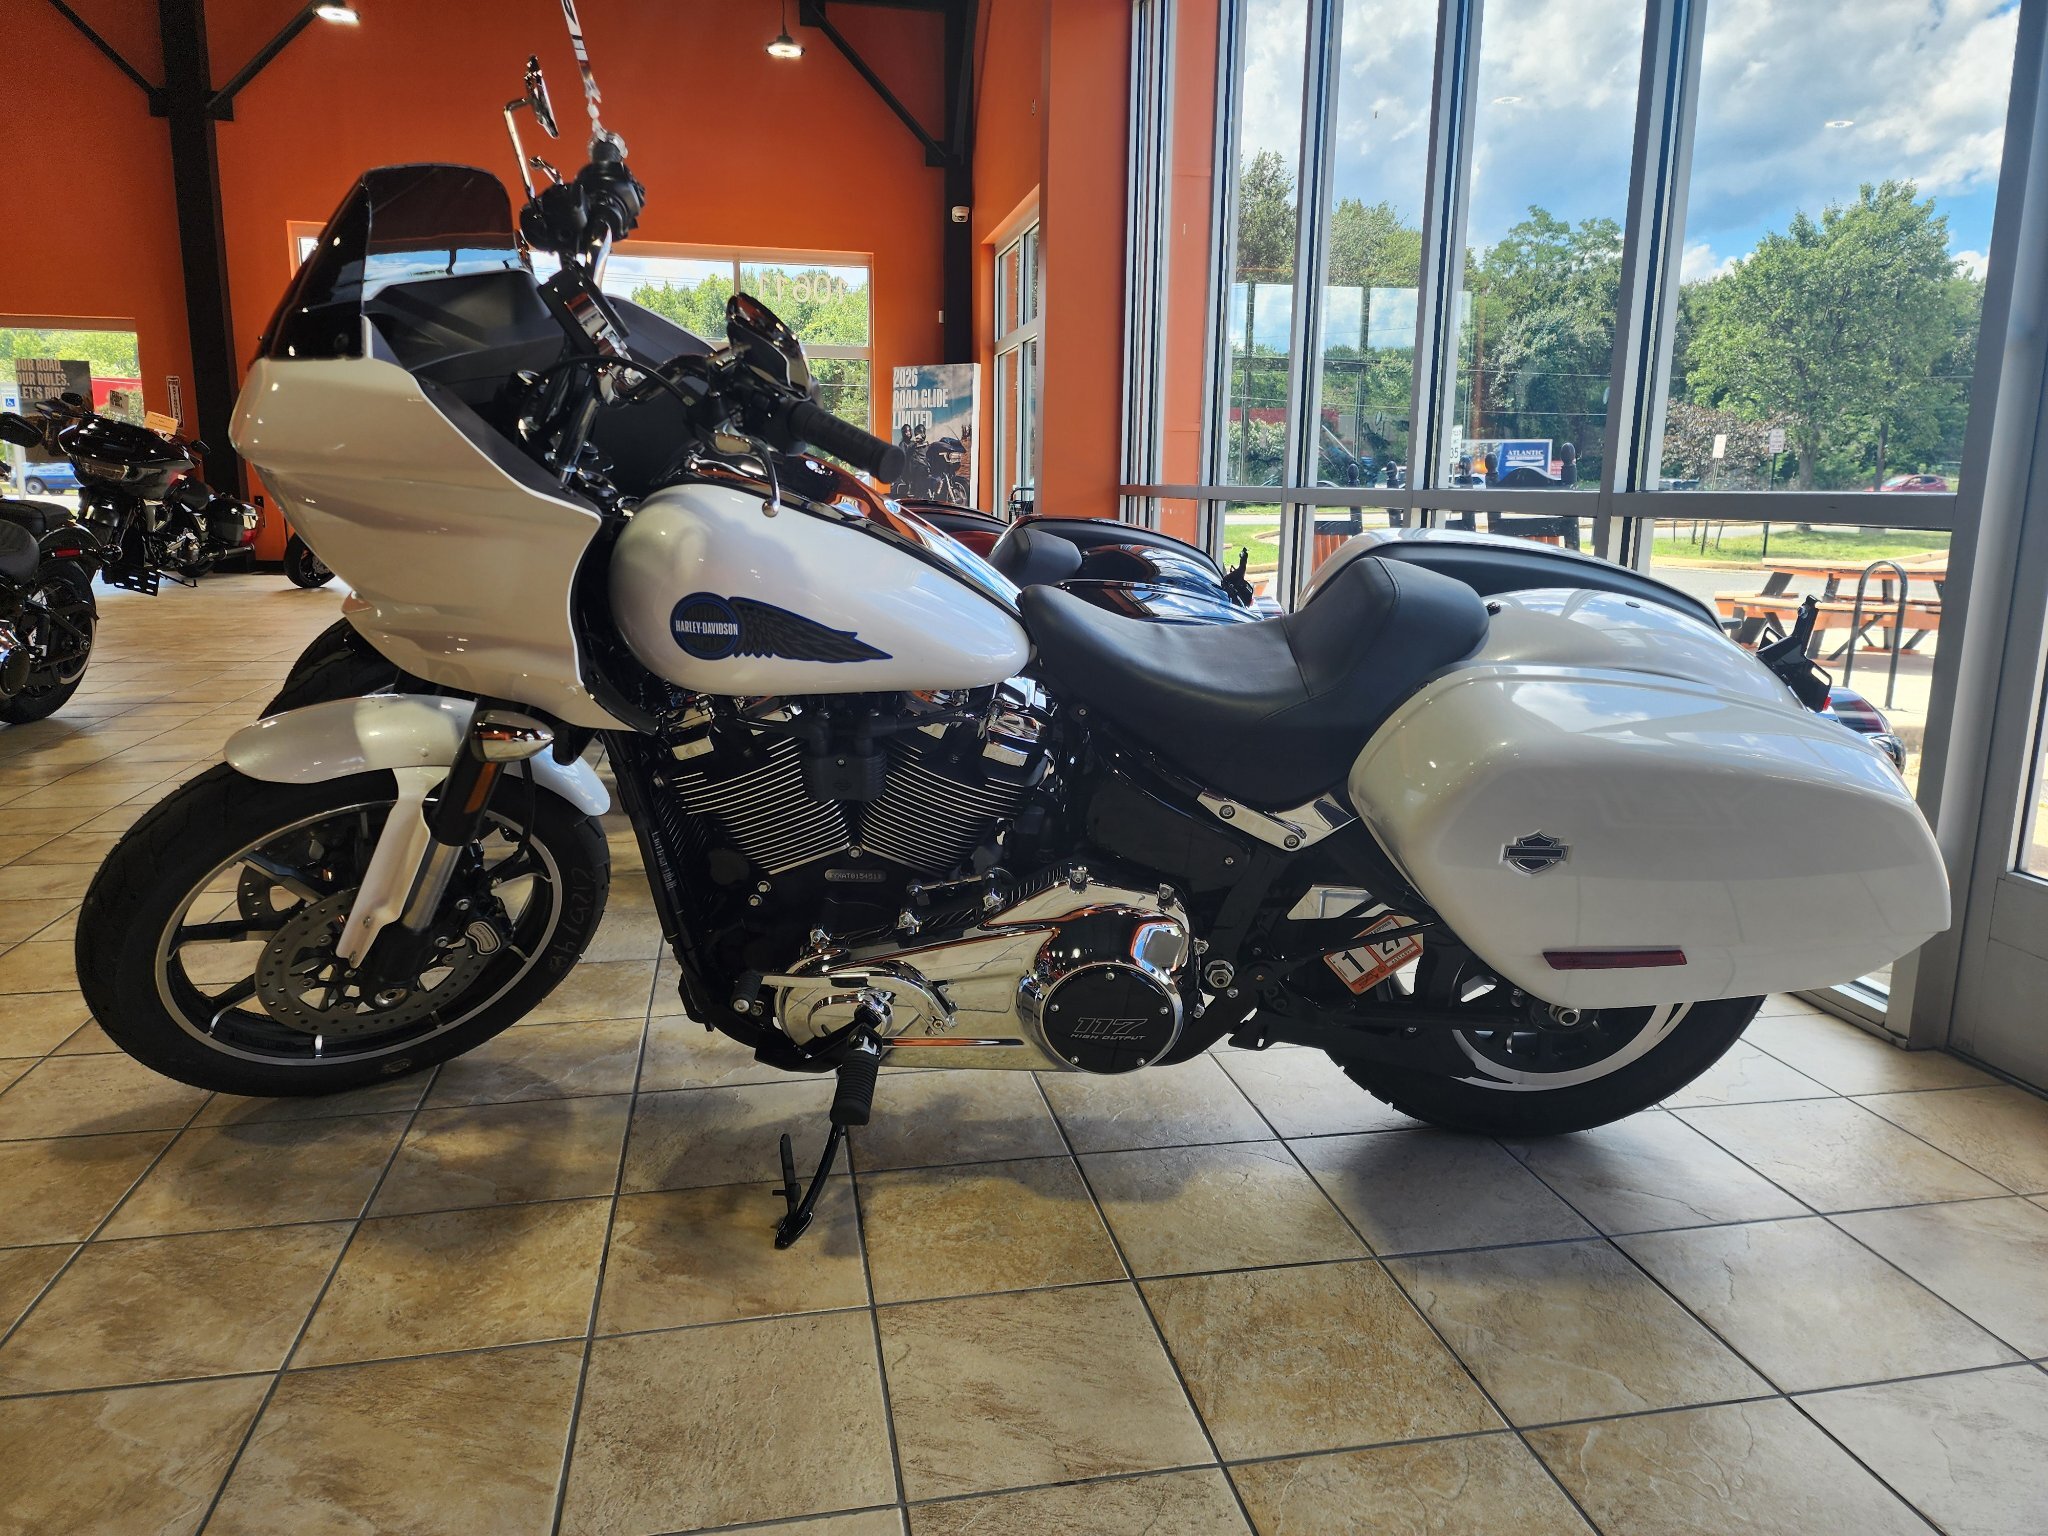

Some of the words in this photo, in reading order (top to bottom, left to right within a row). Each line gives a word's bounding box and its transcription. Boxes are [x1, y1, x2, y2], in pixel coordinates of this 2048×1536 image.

[36, 359, 63, 372] ROAD.
[17, 372, 36, 385] OUR
[37, 373, 70, 386] RULES.
[893, 368, 918, 387] 2026
[18, 386, 43, 399] LET'S
[893, 390, 918, 409] ROAD
[921, 389, 948, 408] GLIDE
[893, 410, 933, 430] LIMITED
[675, 620, 738, 635] HARLEY-DAVIDSON
[1342, 950, 1365, 973] 1
[1074, 1017, 1148, 1035] 117
